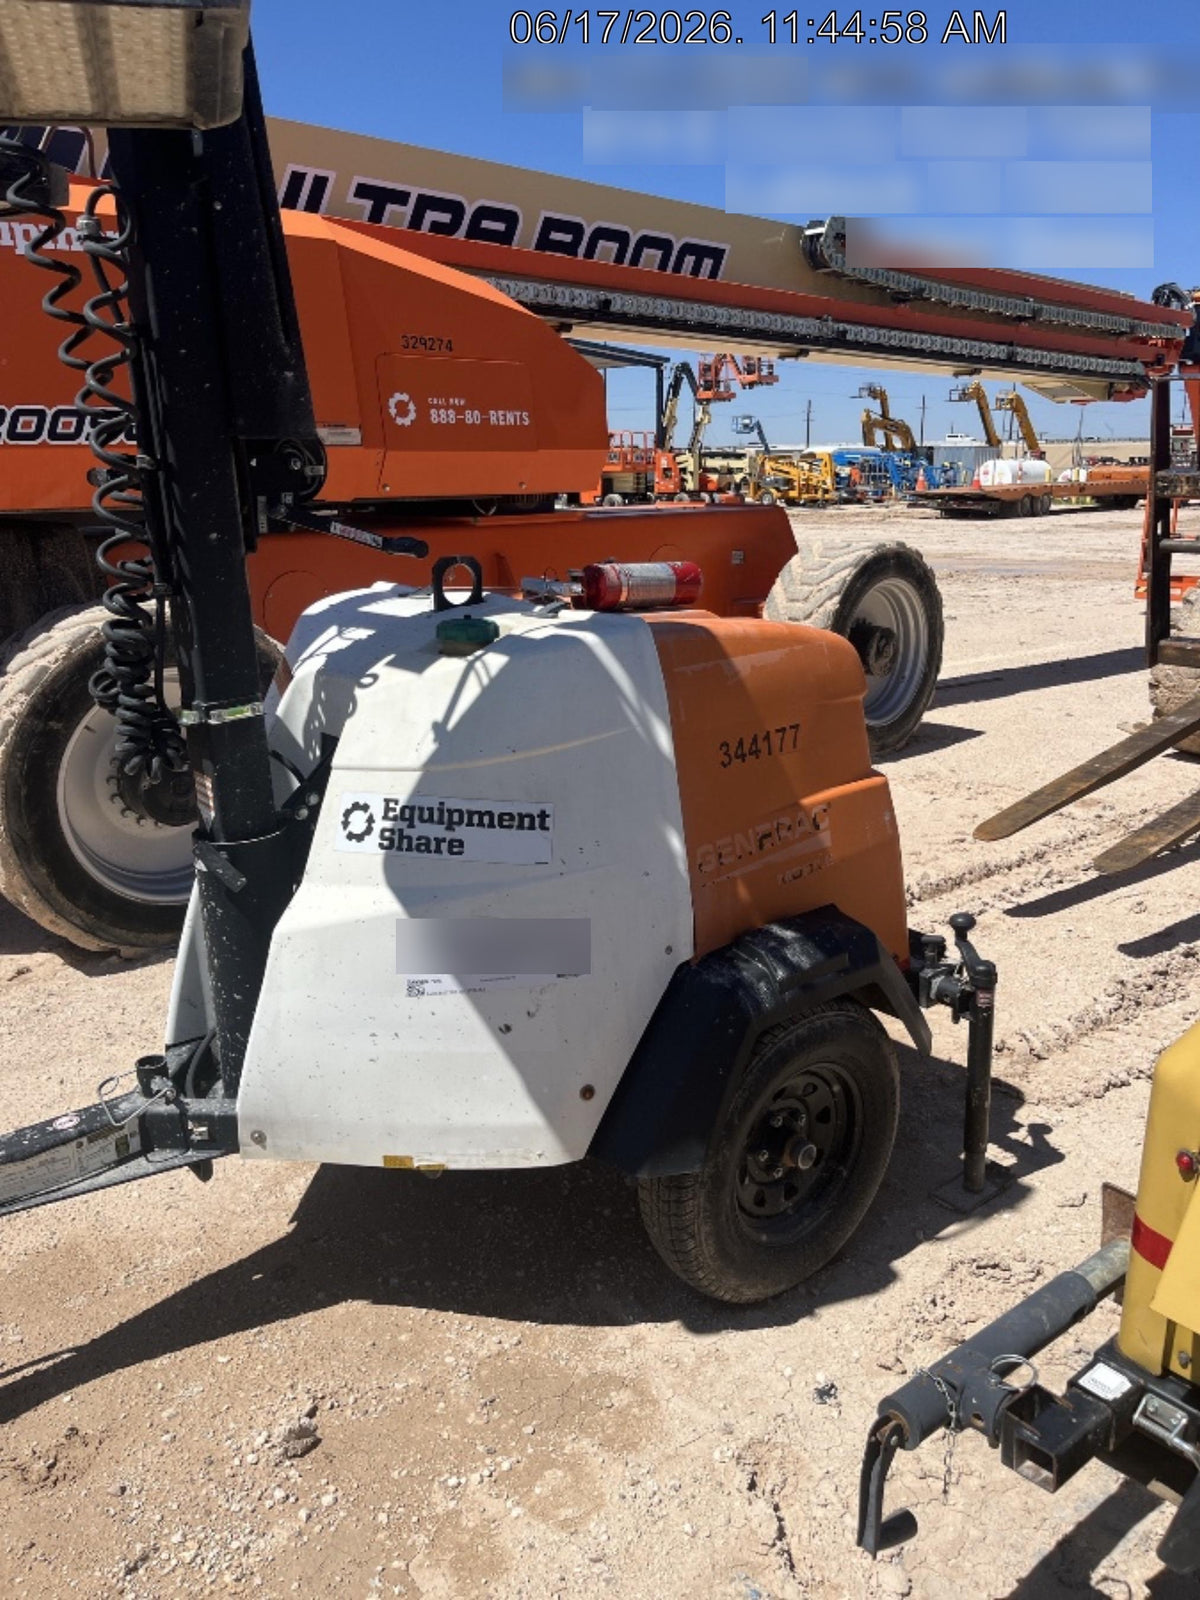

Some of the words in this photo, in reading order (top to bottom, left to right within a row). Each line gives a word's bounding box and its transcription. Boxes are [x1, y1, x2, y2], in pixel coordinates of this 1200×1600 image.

[400, 335, 453, 351] 329274
[429, 408, 531, 427] 888-80-RENTS
[718, 723, 801, 769] 344177
[381, 798, 551, 832] Equipment
[378, 827, 466, 857] Share
